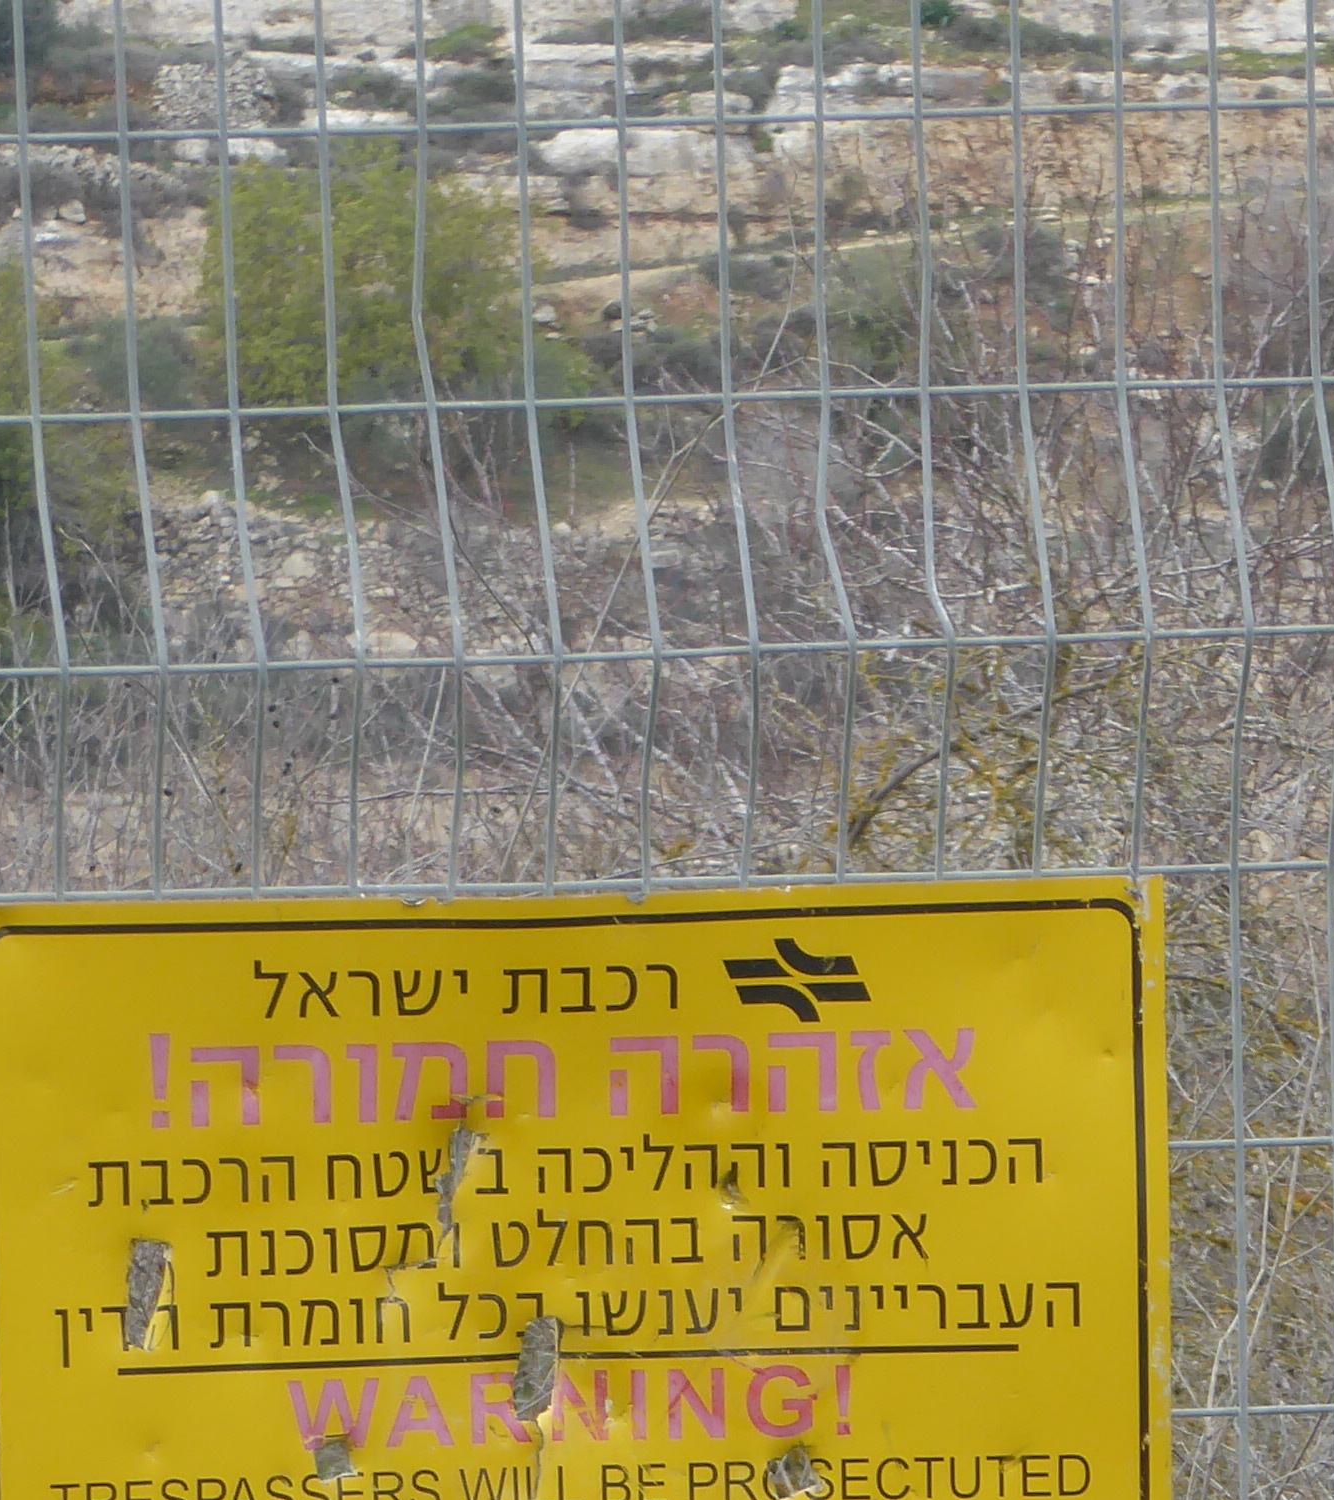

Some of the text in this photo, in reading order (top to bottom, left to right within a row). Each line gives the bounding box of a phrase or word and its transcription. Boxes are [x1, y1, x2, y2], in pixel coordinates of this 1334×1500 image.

[253, 960, 679, 1018] רכבת ישראל
[147, 1028, 977, 1128] אזהרה חמורה!
[87, 1133, 1044, 1208] הכניסה וההליכה בשטח הרכבת
[206, 1208, 929, 1278] אסורה בהחלט ומסוכנת
[209, 1296, 411, 1349] חומרת
[575, 1286, 742, 1338] יענשו
[774, 1281, 1082, 1334] העבריינים
[287, 1364, 852, 1452] WARNING!
